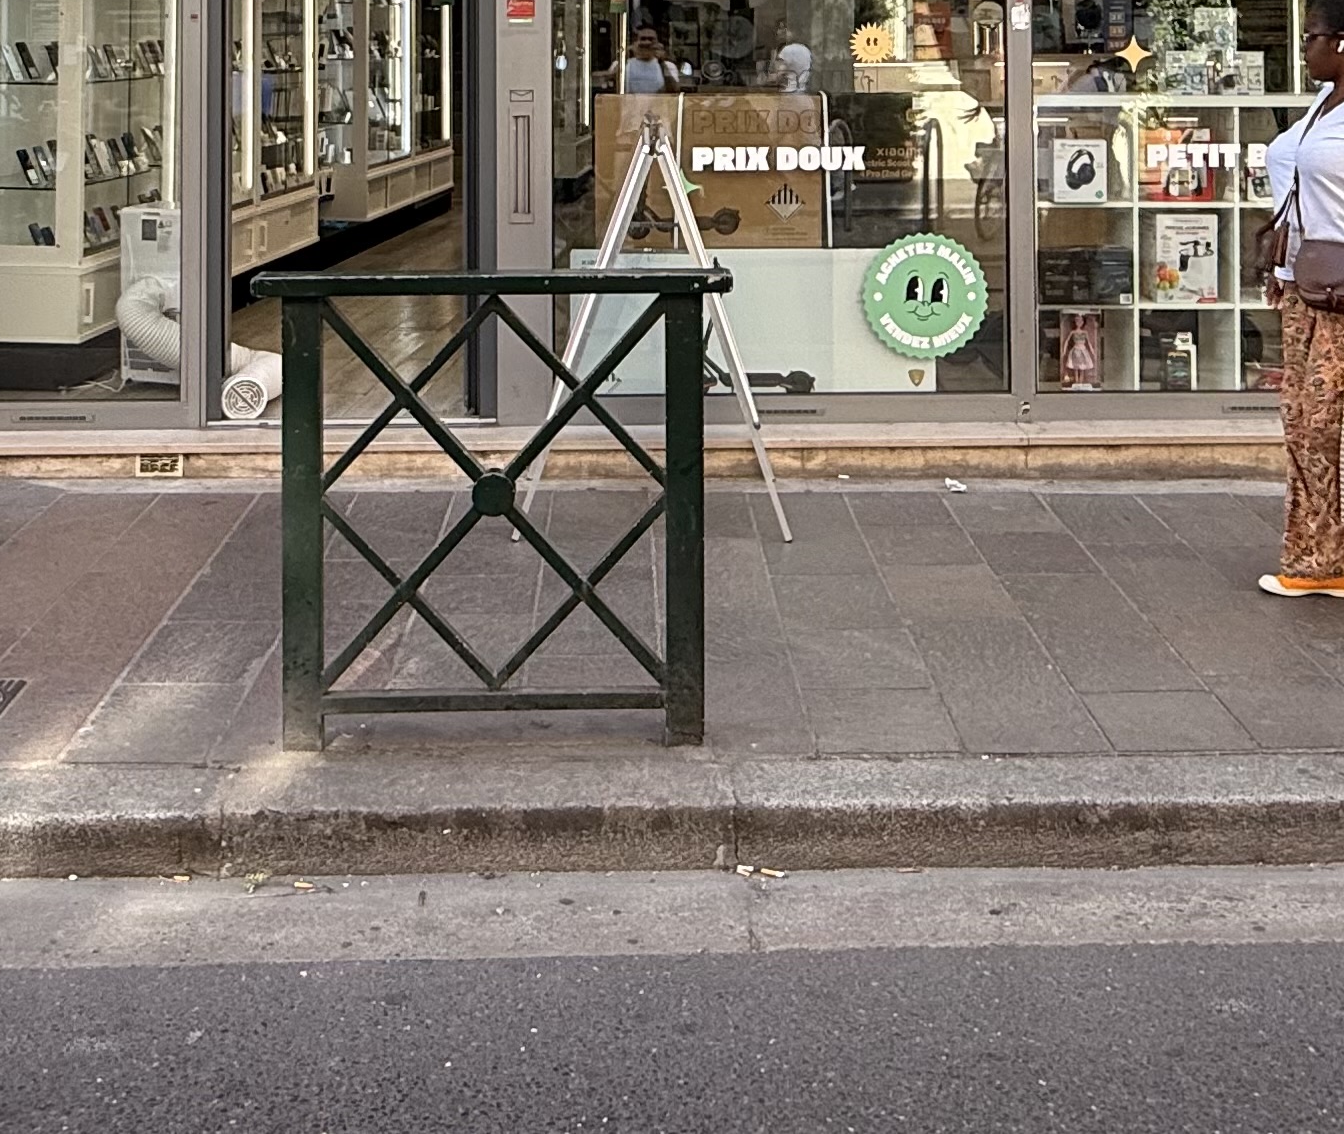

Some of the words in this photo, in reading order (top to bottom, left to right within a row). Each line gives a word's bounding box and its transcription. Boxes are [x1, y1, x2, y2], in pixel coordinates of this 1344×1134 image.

[692, 146, 770, 171] PRIX
[776, 145, 865, 171] DOUX
[1147, 143, 1240, 168] PETIT
[875, 242, 935, 285] ACHETEZ
[936, 244, 976, 285] MALIN
[879, 312, 930, 349] VENDEZ
[932, 312, 973, 348] MIEUX
